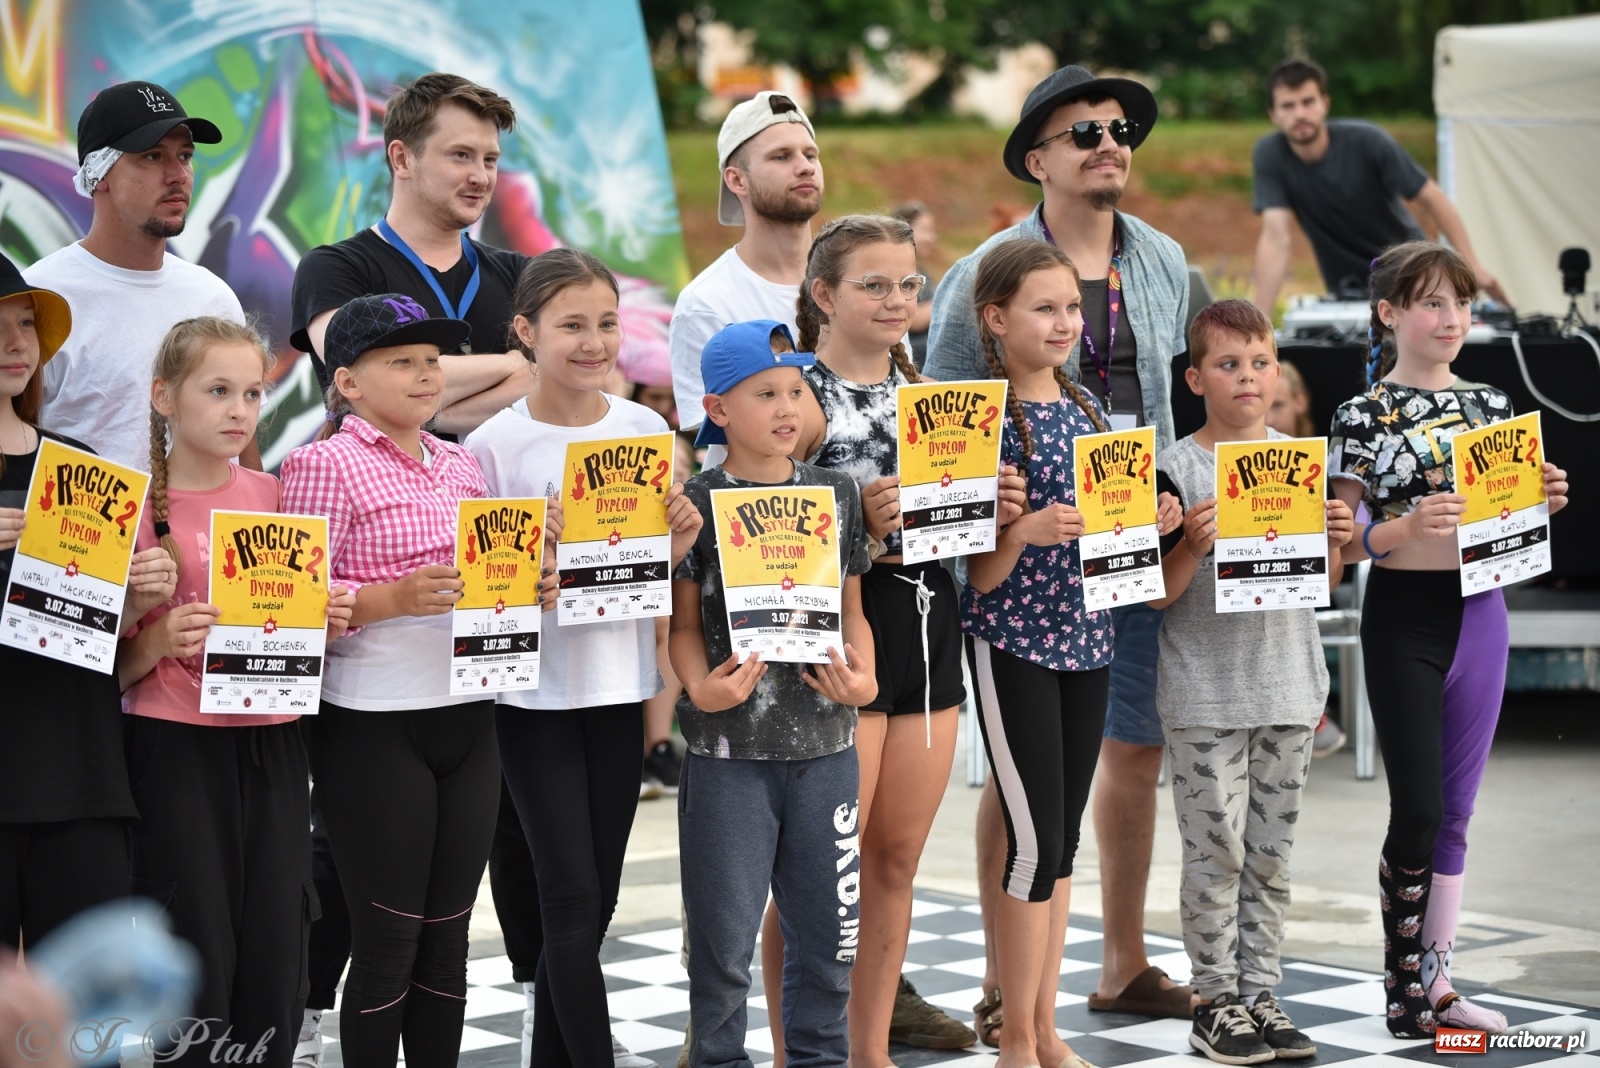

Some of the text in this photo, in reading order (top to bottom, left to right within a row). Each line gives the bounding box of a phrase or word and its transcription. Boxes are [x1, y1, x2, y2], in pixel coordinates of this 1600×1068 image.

[914, 390, 987, 435] ROGUE
[934, 413, 965, 428] STYLE
[978, 405, 999, 432] 2
[929, 440, 967, 457] DYPLOM
[1469, 428, 1527, 475] ROGUE
[1525, 437, 1538, 463] 2
[584, 445, 658, 491] ROGUE
[931, 458, 957, 468] za udział
[1089, 440, 1143, 484] ROGUE
[1138, 453, 1151, 479] 2
[1488, 452, 1513, 468] STYLE
[650, 460, 669, 487] 2
[1106, 463, 1128, 478] STYLE
[1236, 448, 1309, 490] ROGUE
[1302, 463, 1321, 488] 2
[604, 470, 637, 485] STYLE
[1257, 471, 1288, 485] STYLE
[1486, 475, 1519, 495] DYPLOM
[57, 463, 129, 523] ROGUE
[939, 490, 979, 504] JURECZKA
[1102, 489, 1131, 506] DYPLOM
[1497, 493, 1513, 503] udział
[74, 492, 105, 513] STYLE
[596, 497, 638, 513] DYPLOM
[1111, 506, 1126, 515] udział
[1252, 497, 1291, 512] DYPLOM
[115, 500, 138, 530] 2
[597, 515, 627, 525] za udział
[735, 496, 817, 538] ROGUE
[930, 507, 962, 522] 3.07.2021
[1262, 514, 1283, 522] udział
[60, 517, 101, 546] DYPLOM
[474, 507, 533, 554] ROGUE
[763, 519, 797, 533] STYLE
[814, 513, 832, 538] 2
[1470, 516, 1527, 542] EMILII RATUŚ
[59, 541, 89, 555] za udział
[233, 523, 311, 573] ROGUE
[492, 534, 516, 548] STYLE
[526, 525, 541, 555] 2
[1491, 536, 1523, 554] 3.07.2021
[257, 552, 289, 567] STYLE
[570, 552, 609, 566] ANTONINY
[760, 545, 805, 559] DYPLOM
[1227, 547, 1261, 557] PATRYKA
[305, 546, 324, 576] 2
[776, 562, 798, 570] udział
[1108, 555, 1135, 570] 3.07.2021
[1253, 562, 1290, 574] 3.07.2021
[486, 562, 518, 579] DYPLOM
[595, 568, 633, 581] 3.07.2021
[21, 571, 113, 606] NATALII MACKIEWICZ
[250, 579, 294, 598] DYPLOM
[494, 582, 510, 591] udział
[44, 597, 83, 620] 3.07.2021
[262, 601, 284, 610] udział
[744, 596, 785, 607] MICHAŁA
[771, 612, 809, 624] 3.07.2021
[225, 640, 307, 651] AMELII BOCHENEK
[483, 638, 511, 651] 3.07.2021
[246, 658, 286, 671] 3.07.2021
